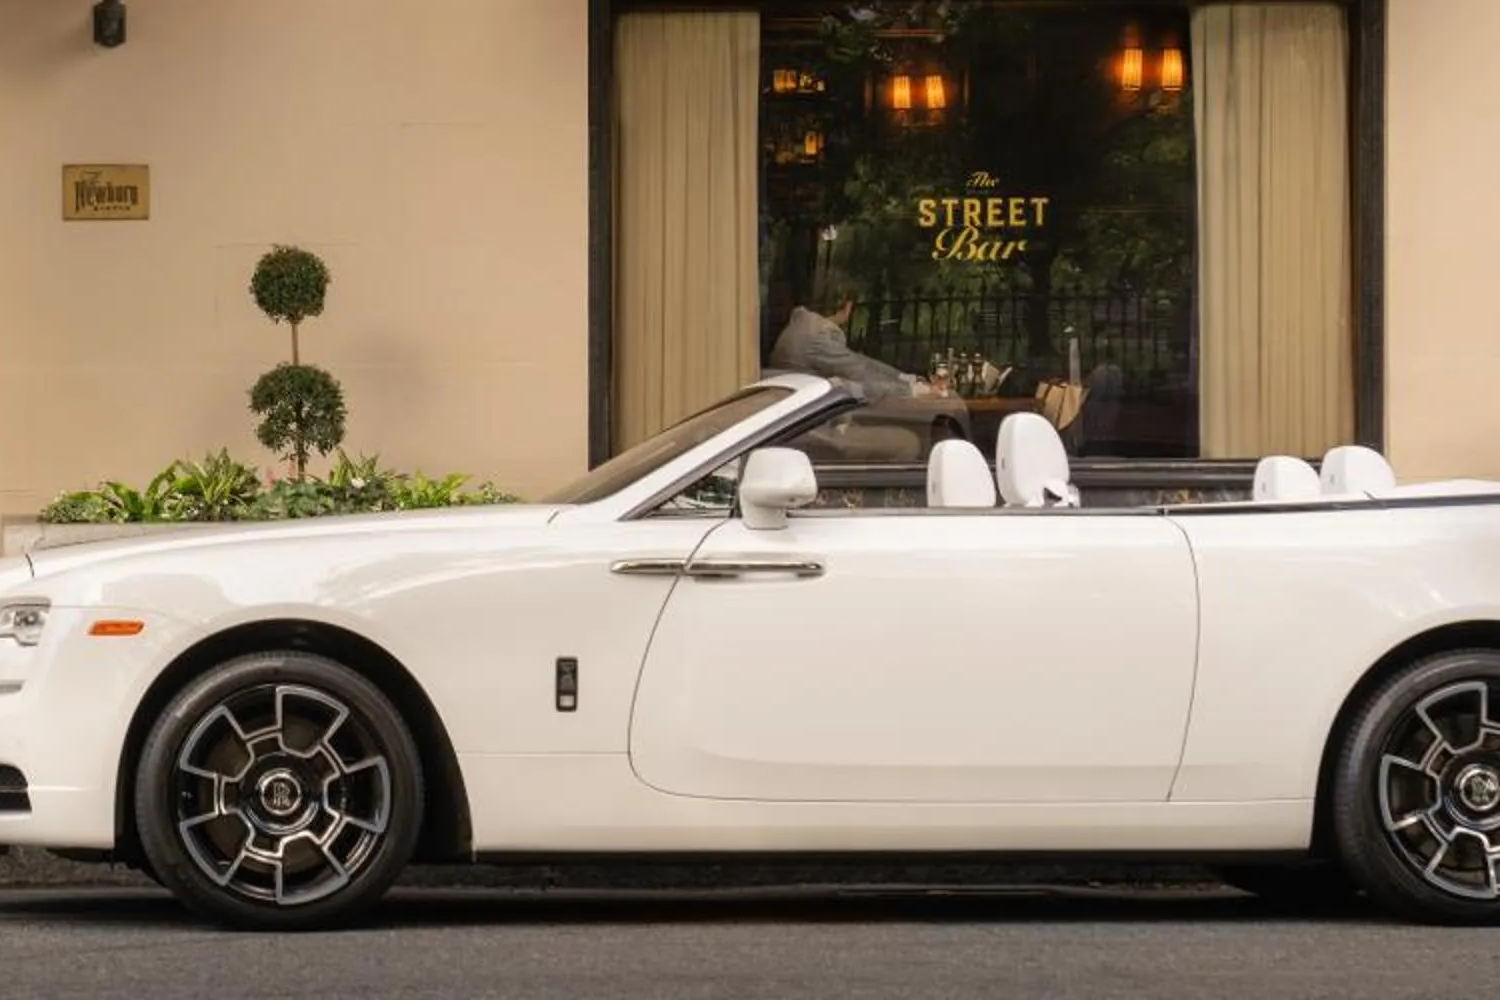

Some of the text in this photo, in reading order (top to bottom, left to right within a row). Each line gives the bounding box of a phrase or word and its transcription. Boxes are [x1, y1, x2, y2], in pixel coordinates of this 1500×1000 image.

[966, 171, 999, 187] The
[918, 197, 1049, 227] STREET
[931, 225, 1028, 261] Bar
